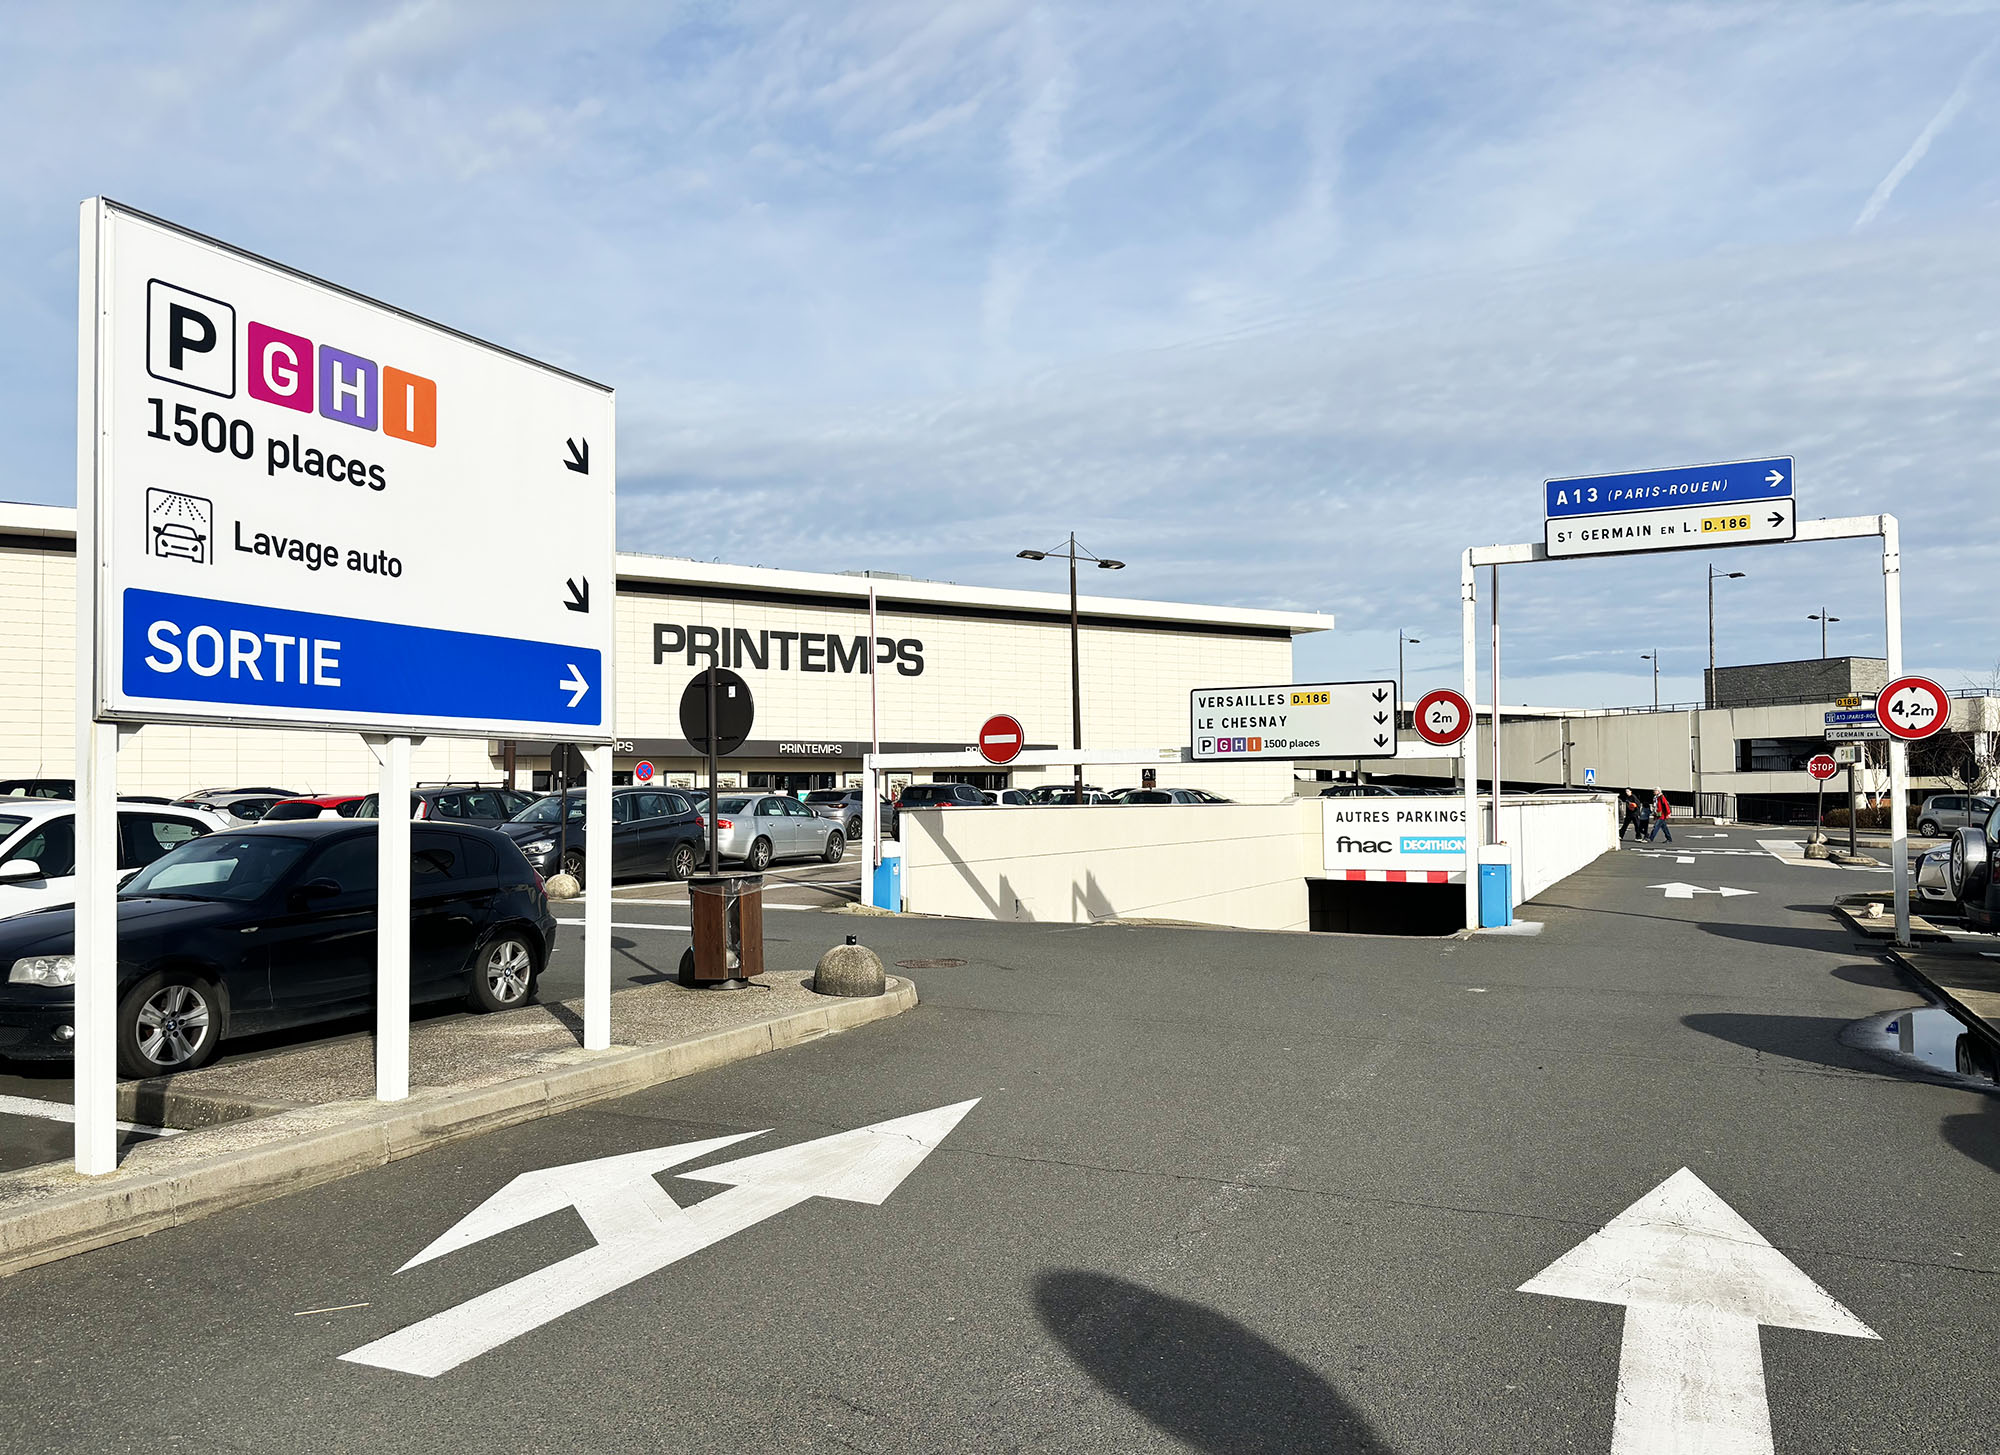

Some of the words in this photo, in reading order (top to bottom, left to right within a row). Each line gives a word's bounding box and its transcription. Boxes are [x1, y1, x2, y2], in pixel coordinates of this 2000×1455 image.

[169, 302, 217, 371] P
[262, 341, 299, 396] G
[333, 360, 366, 419] H
[405, 383, 415, 433] I
[147, 397, 254, 460] 1500
[267, 434, 387, 491] places
[1556, 487, 1599, 506] A13
[1607, 479, 1728, 502] (PARIS-ROUEN)
[1581, 525, 1651, 541] GERMAIN
[1660, 525, 1675, 535] EN
[1683, 522, 1698, 533] L.
[1703, 517, 1747, 531] D.186
[234, 520, 340, 572] Lavage
[347, 546, 403, 578] auto
[144, 619, 342, 687] SORTIE
[653, 623, 924, 677] PRINTEMPS
[1198, 694, 1285, 708] VERSAILLES
[1292, 692, 1328, 705] D.186
[1891, 700, 1935, 718] 4,2m
[1198, 718, 1214, 730] LE
[1221, 715, 1287, 729] CHESNAY
[1432, 711, 1452, 723] 2m
[779, 743, 843, 754] PRINTEMPS
[1202, 740, 1212, 752] P
[1219, 740, 1229, 751] G
[1234, 740, 1244, 750] H
[1263, 738, 1287, 749] 1500
[1289, 738, 1320, 750] places
[1811, 762, 1834, 772] STOP
[1335, 811, 1390, 823] AUTRES
[1396, 810, 1466, 823] PARKINGS
[1335, 835, 1393, 853] fnac
[1403, 839, 1466, 851] DECATHLON
